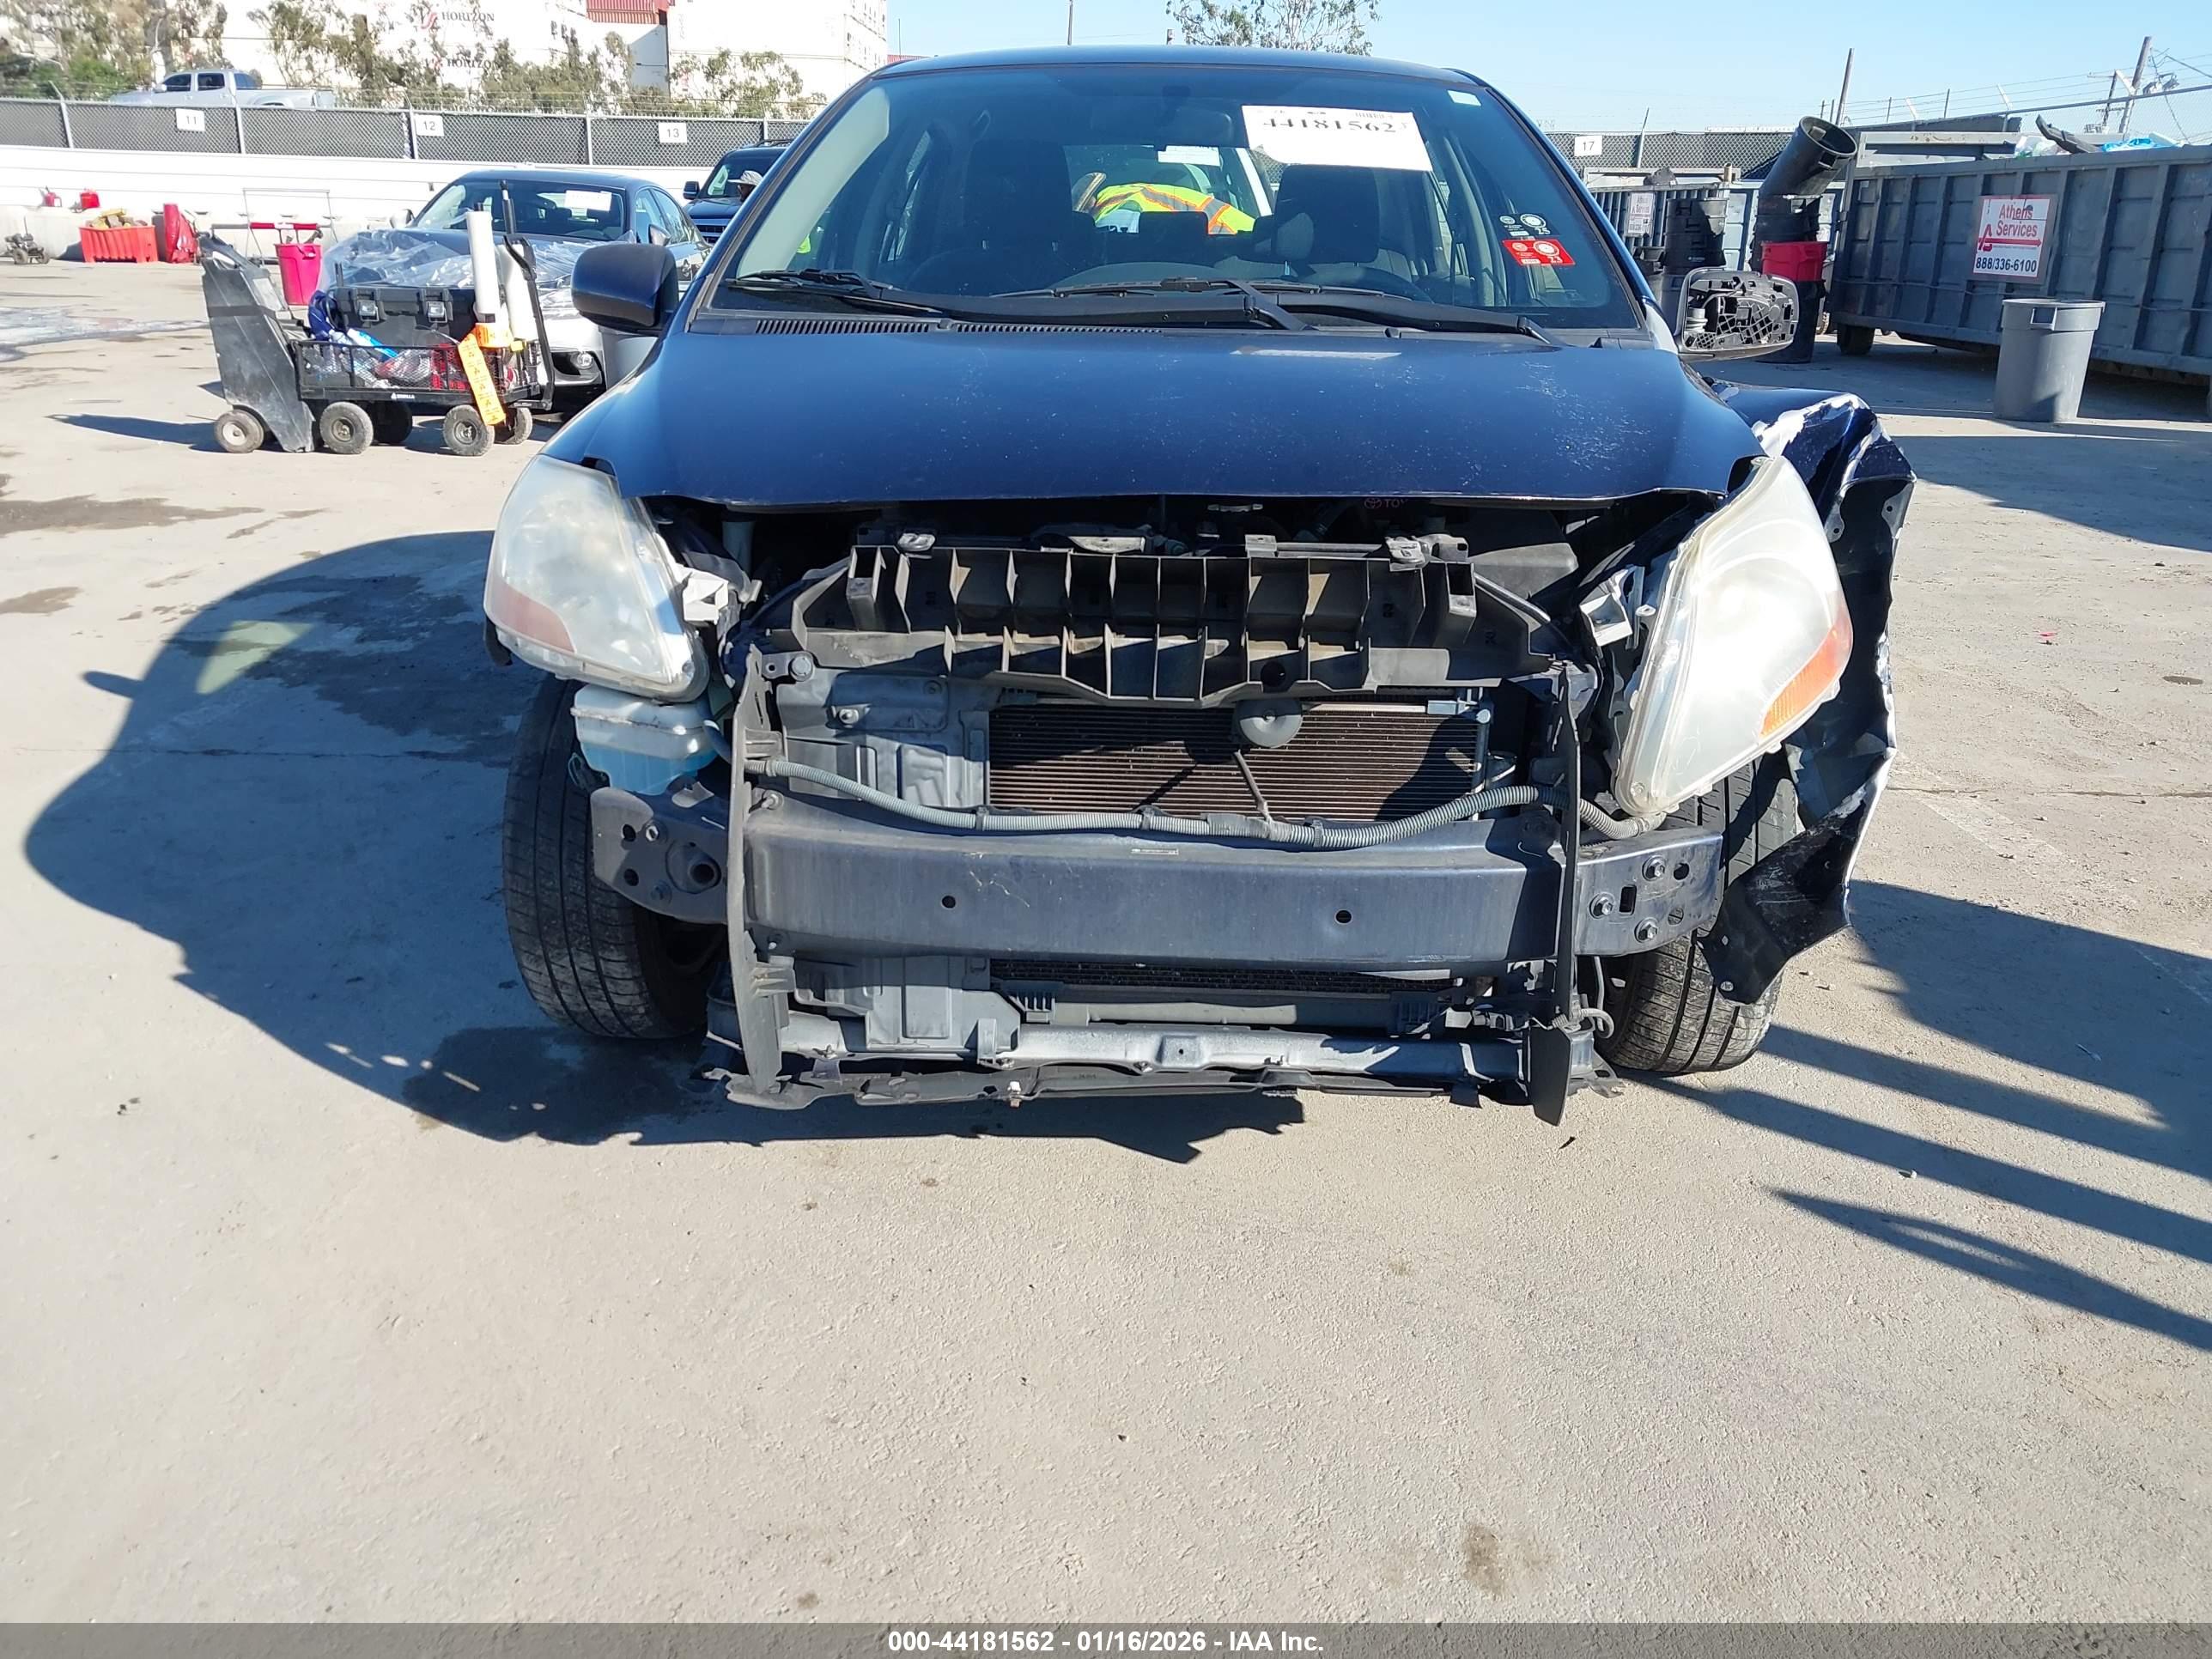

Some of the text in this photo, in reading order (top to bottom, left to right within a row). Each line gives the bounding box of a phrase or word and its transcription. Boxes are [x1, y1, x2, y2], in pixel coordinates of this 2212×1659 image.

[442, 11, 495, 21] HORIZON
[447, 58, 493, 69] HORIZO
[186, 116, 197, 125] 11
[1263, 118, 1397, 132] 44181562
[423, 121, 436, 131] 12
[666, 128, 680, 137] 13
[1583, 141, 1595, 151] 17
[1999, 204, 2034, 220] Athens
[1996, 221, 2038, 237] Services
[1976, 257, 2037, 273] 888/336-6100
